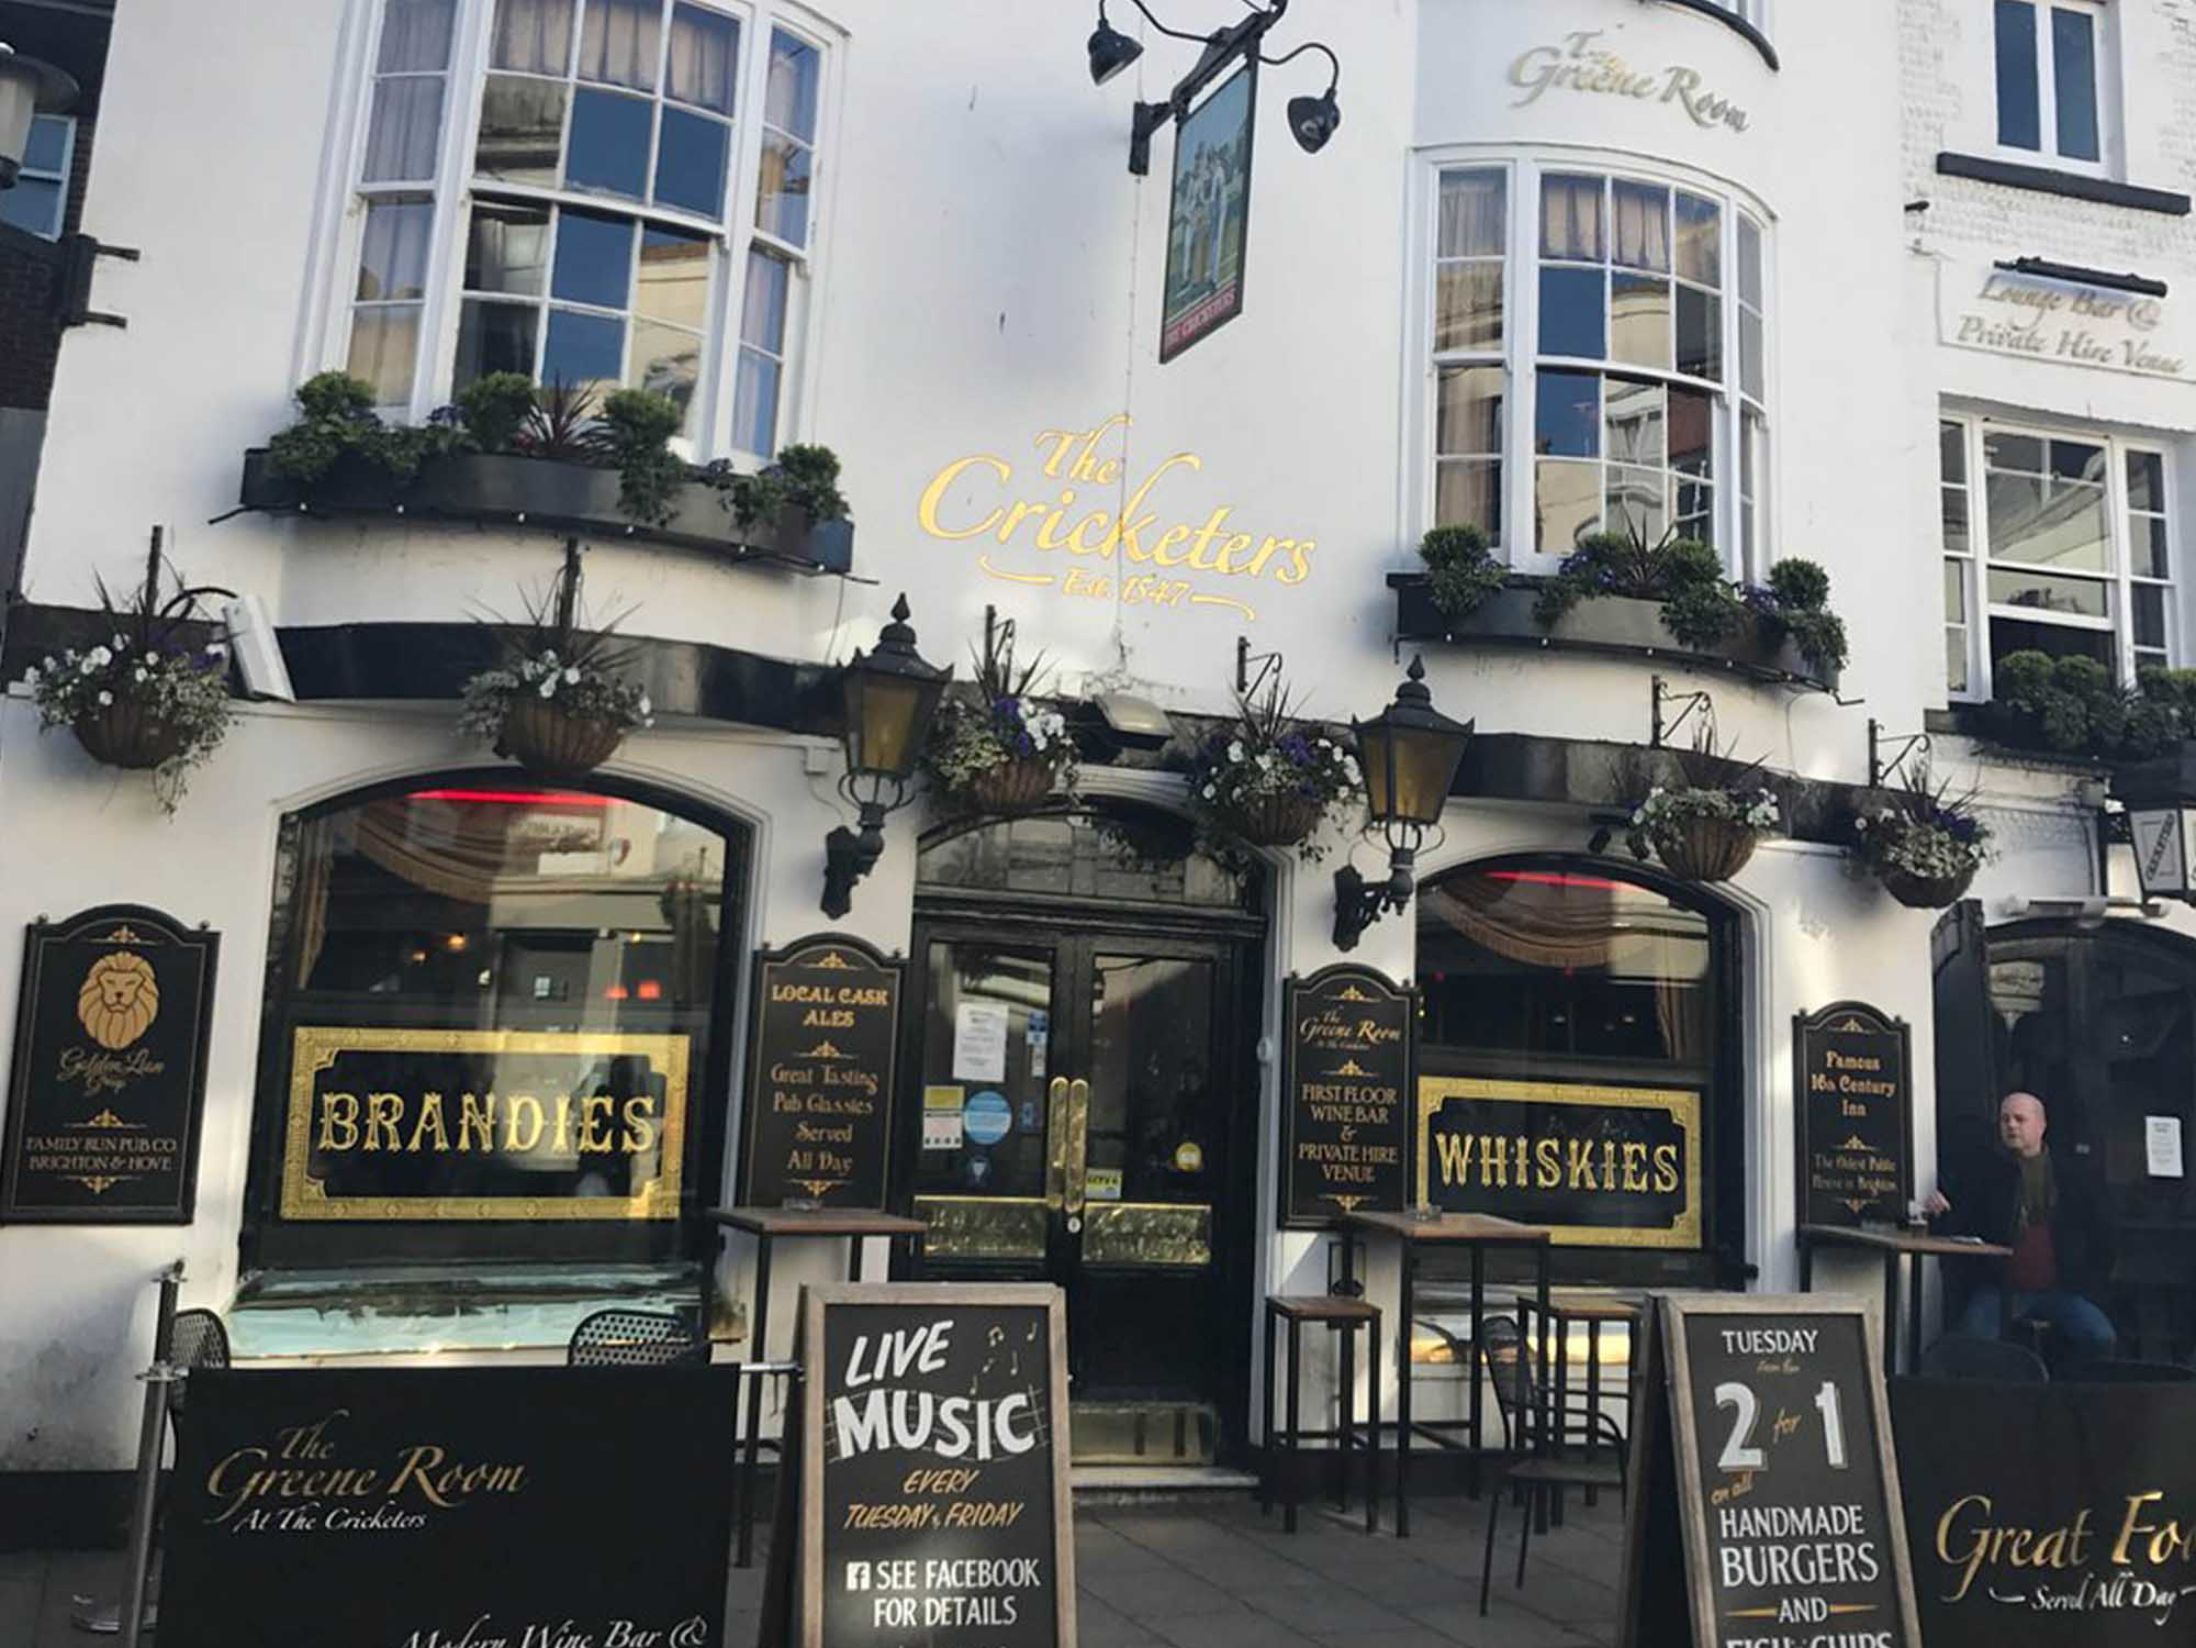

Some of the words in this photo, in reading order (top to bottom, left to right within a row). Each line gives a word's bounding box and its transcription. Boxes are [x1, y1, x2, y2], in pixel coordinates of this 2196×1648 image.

[1507, 46, 1659, 109] Greene
[1659, 65, 1750, 134] Room
[1957, 314, 2047, 353] Private
[2055, 329, 2113, 364] Hire
[1033, 412, 1135, 486] The
[917, 453, 1318, 587] Cricketers
[771, 984, 835, 1004] LOCAL
[837, 988, 888, 1007] CASK
[803, 1009, 855, 1028] ALES
[1826, 1051, 1880, 1071] Famous
[770, 1062, 814, 1085] Great
[822, 1064, 879, 1095] Tasting
[1839, 1075, 1896, 1099] Century
[773, 1091, 803, 1113] Pub
[806, 1093, 873, 1115] Classics
[1302, 1084, 1342, 1102] FIRST
[1343, 1086, 1398, 1105] FLOOR
[1842, 1099, 1868, 1117] Inn
[317, 1090, 658, 1154] BRANDIES
[1310, 1105, 1354, 1124] WINE
[1355, 1106, 1390, 1125] BAR
[26, 1137, 81, 1151] FAMILY
[84, 1137, 118, 1152] RUN
[120, 1138, 149, 1153] PUB
[151, 1138, 177, 1153] CO
[796, 1120, 853, 1142] Served
[1339, 1125, 1357, 1142] &
[29, 1154, 108, 1171] BRIGHTON
[109, 1156, 126, 1171] &
[128, 1157, 172, 1171] HOVE
[786, 1150, 814, 1171] All
[819, 1153, 852, 1177] Day
[1299, 1142, 1359, 1162] PRIVATE
[1361, 1146, 1399, 1164] HIRE
[1434, 1131, 1680, 1193] WHISKIES
[1322, 1163, 1375, 1183] VENUE
[845, 1319, 954, 1387] LIVE
[1721, 1330, 1819, 1354] TUESDAY
[279, 1408, 350, 1460] The
[833, 1388, 1036, 1461] MUSIC
[1714, 1381, 1768, 1472] 2
[1773, 1407, 1802, 1444] for
[1814, 1381, 1849, 1469] 1
[203, 1447, 377, 1524] Greene
[388, 1445, 530, 1508] Room
[903, 1468, 980, 1494] EVERY
[232, 1507, 269, 1533] At
[275, 1501, 322, 1531] The
[323, 1500, 430, 1531] Cricketers
[843, 1502, 932, 1529] TUESDAY
[943, 1502, 1025, 1529] FRIDAY
[1719, 1505, 1866, 1539] HANDMADE
[1935, 1492, 2095, 1603] Great
[875, 1559, 917, 1590] SEE
[924, 1557, 1042, 1589] FACEBOOK
[1719, 1542, 1880, 1588] BURGERS
[873, 1596, 918, 1628] FOR
[924, 1595, 1019, 1626] DETAILS
[1778, 1596, 1829, 1624] AND
[2131, 1580, 2179, 1627] Day
[520, 1619, 597, 1648] Wine
[605, 1620, 662, 1648] Bar
